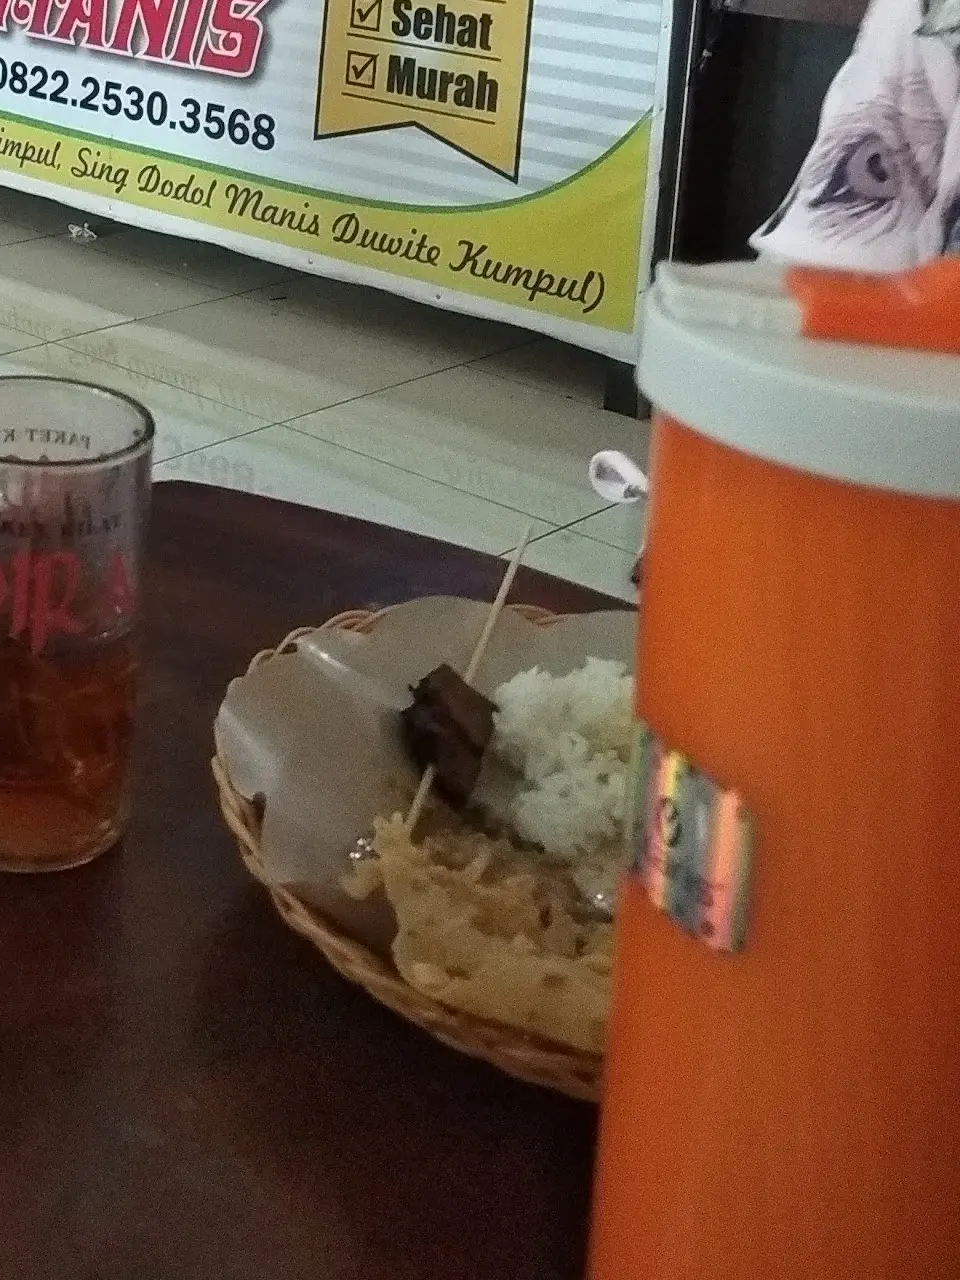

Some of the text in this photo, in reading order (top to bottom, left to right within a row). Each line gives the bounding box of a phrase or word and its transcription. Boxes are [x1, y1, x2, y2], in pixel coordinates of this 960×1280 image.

[386, 54, 498, 113] Murah
[70, 147, 130, 193] Sing
[137, 164, 218, 208] Dodol
[225, 183, 320, 236] Manis
[331, 212, 441, 267] Duwite
[449, 239, 605, 314] Kumpul)
